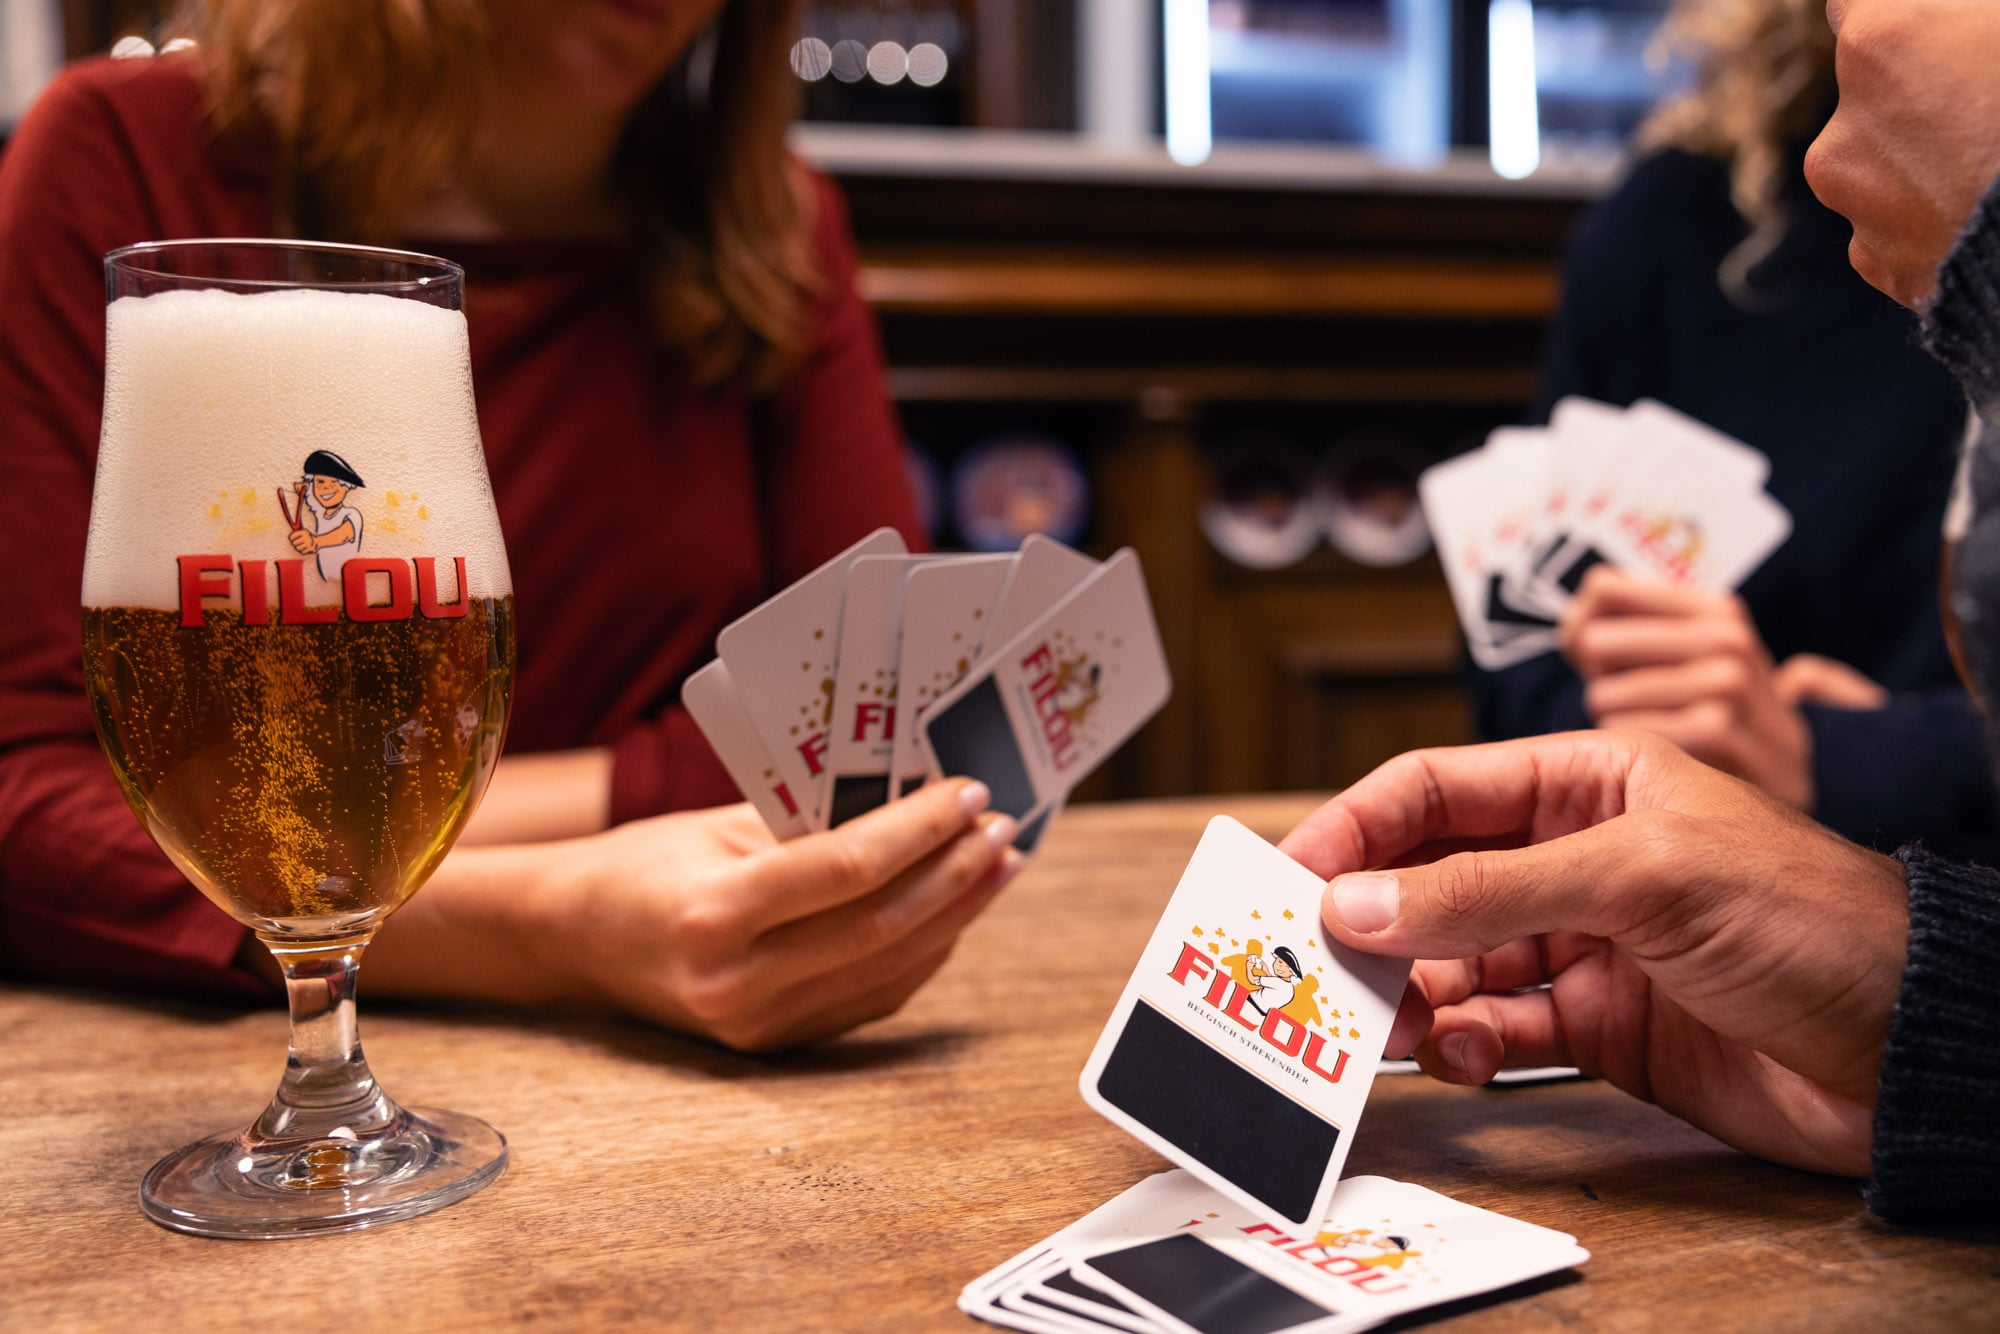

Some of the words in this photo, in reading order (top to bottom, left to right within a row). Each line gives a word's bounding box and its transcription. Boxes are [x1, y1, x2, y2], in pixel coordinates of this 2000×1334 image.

[177, 554, 469, 628] FILOU
[1021, 643, 1082, 774] FILOU
[1167, 941, 1352, 1084] FILOU
[1187, 1001, 1237, 1038] BELGISCH
[1239, 1036, 1309, 1085] STREKENBIER
